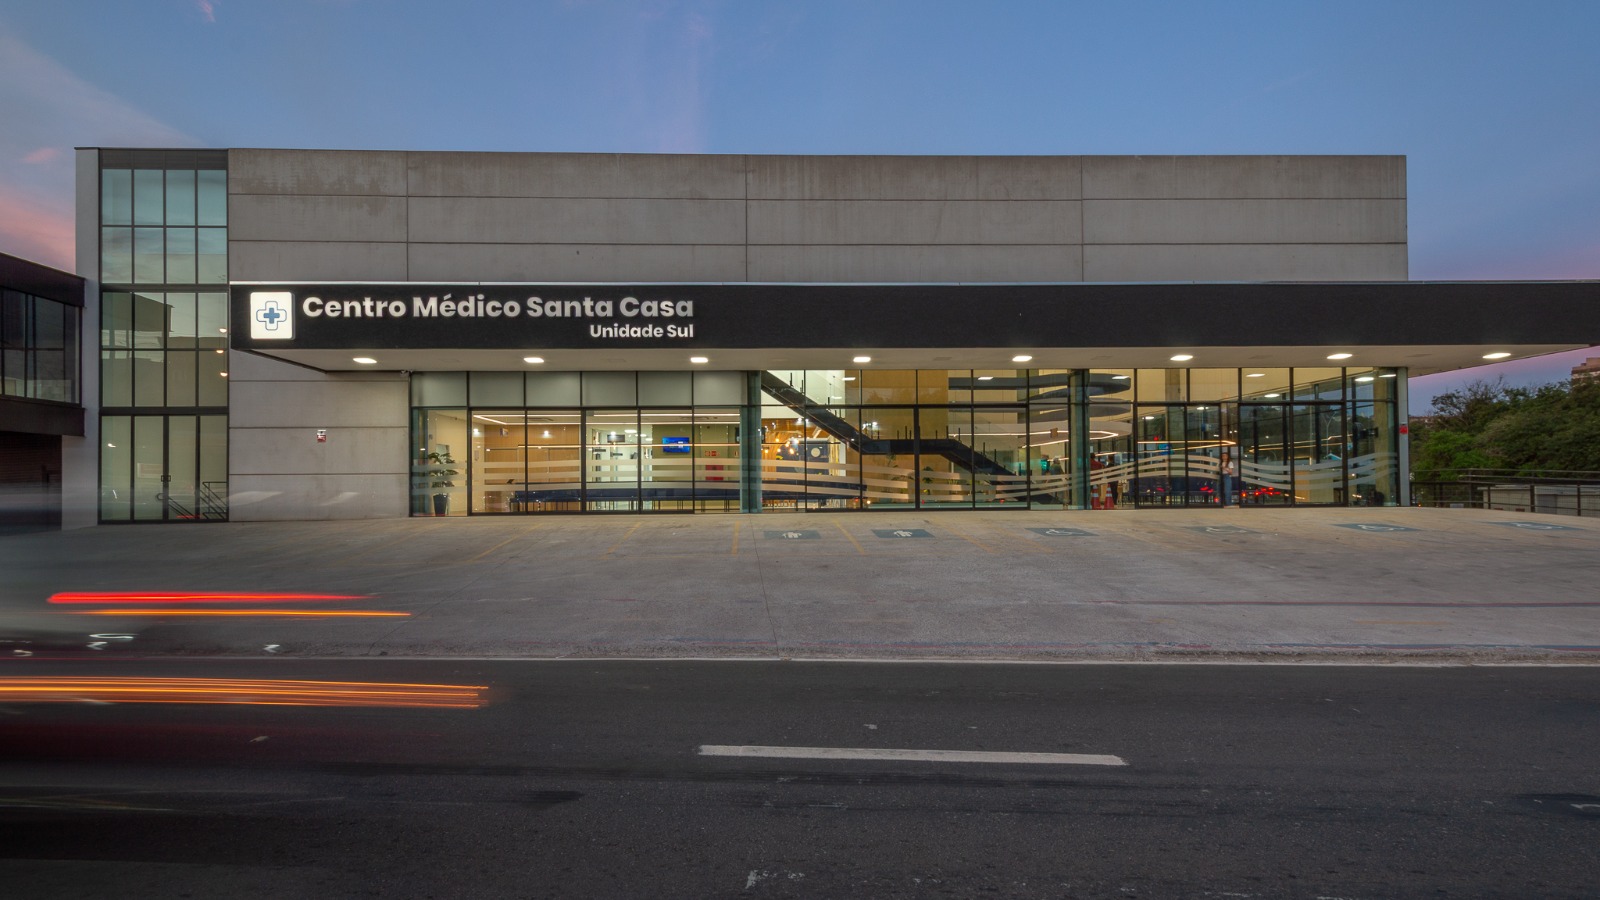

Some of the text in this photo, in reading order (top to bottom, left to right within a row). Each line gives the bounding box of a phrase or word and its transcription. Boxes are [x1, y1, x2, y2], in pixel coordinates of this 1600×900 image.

[302, 293, 694, 318] Centro Médico Santa Casa
[589, 323, 694, 338] Unidade Sul
